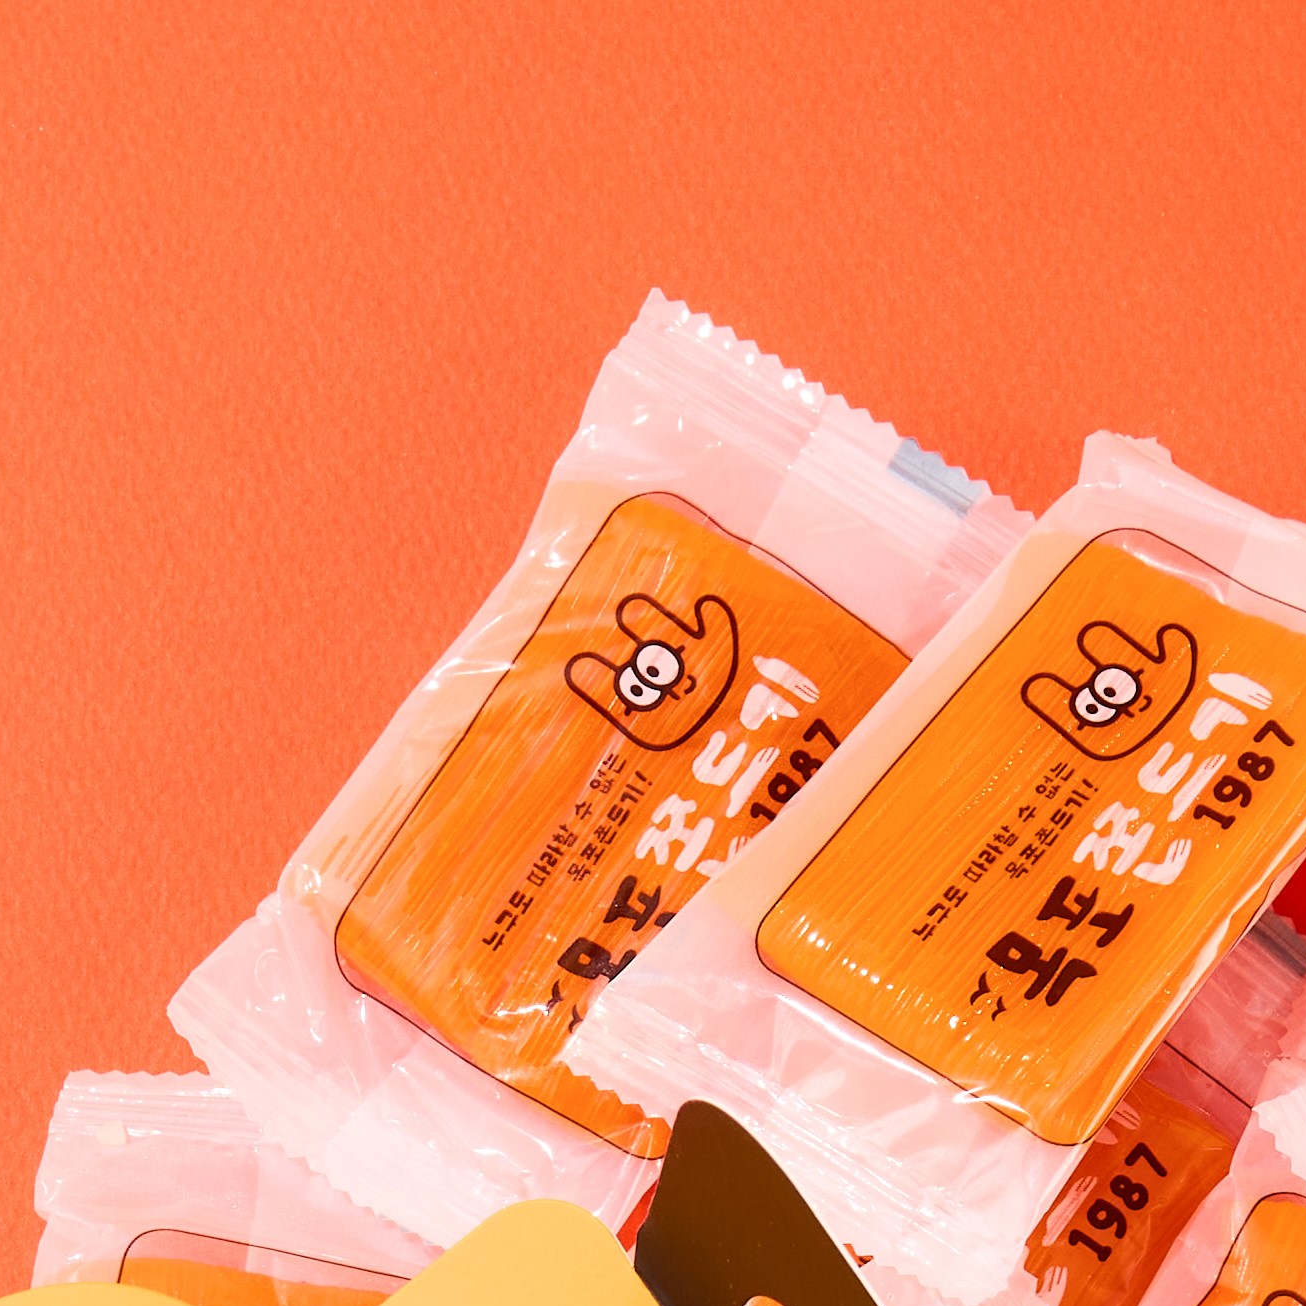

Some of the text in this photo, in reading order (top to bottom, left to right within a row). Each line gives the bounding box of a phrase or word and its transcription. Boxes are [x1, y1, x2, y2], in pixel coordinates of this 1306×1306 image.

[749, 717, 845, 827] 1987
[984, 671, 1274, 1008] 목포쫀드기
[1192, 718, 1296, 831] 1987
[481, 752, 628, 952] 누구도 따라할 수 없는
[911, 761, 1076, 943] 누구도 따라할 수 없는
[1067, 1142, 1169, 1263] 1987
